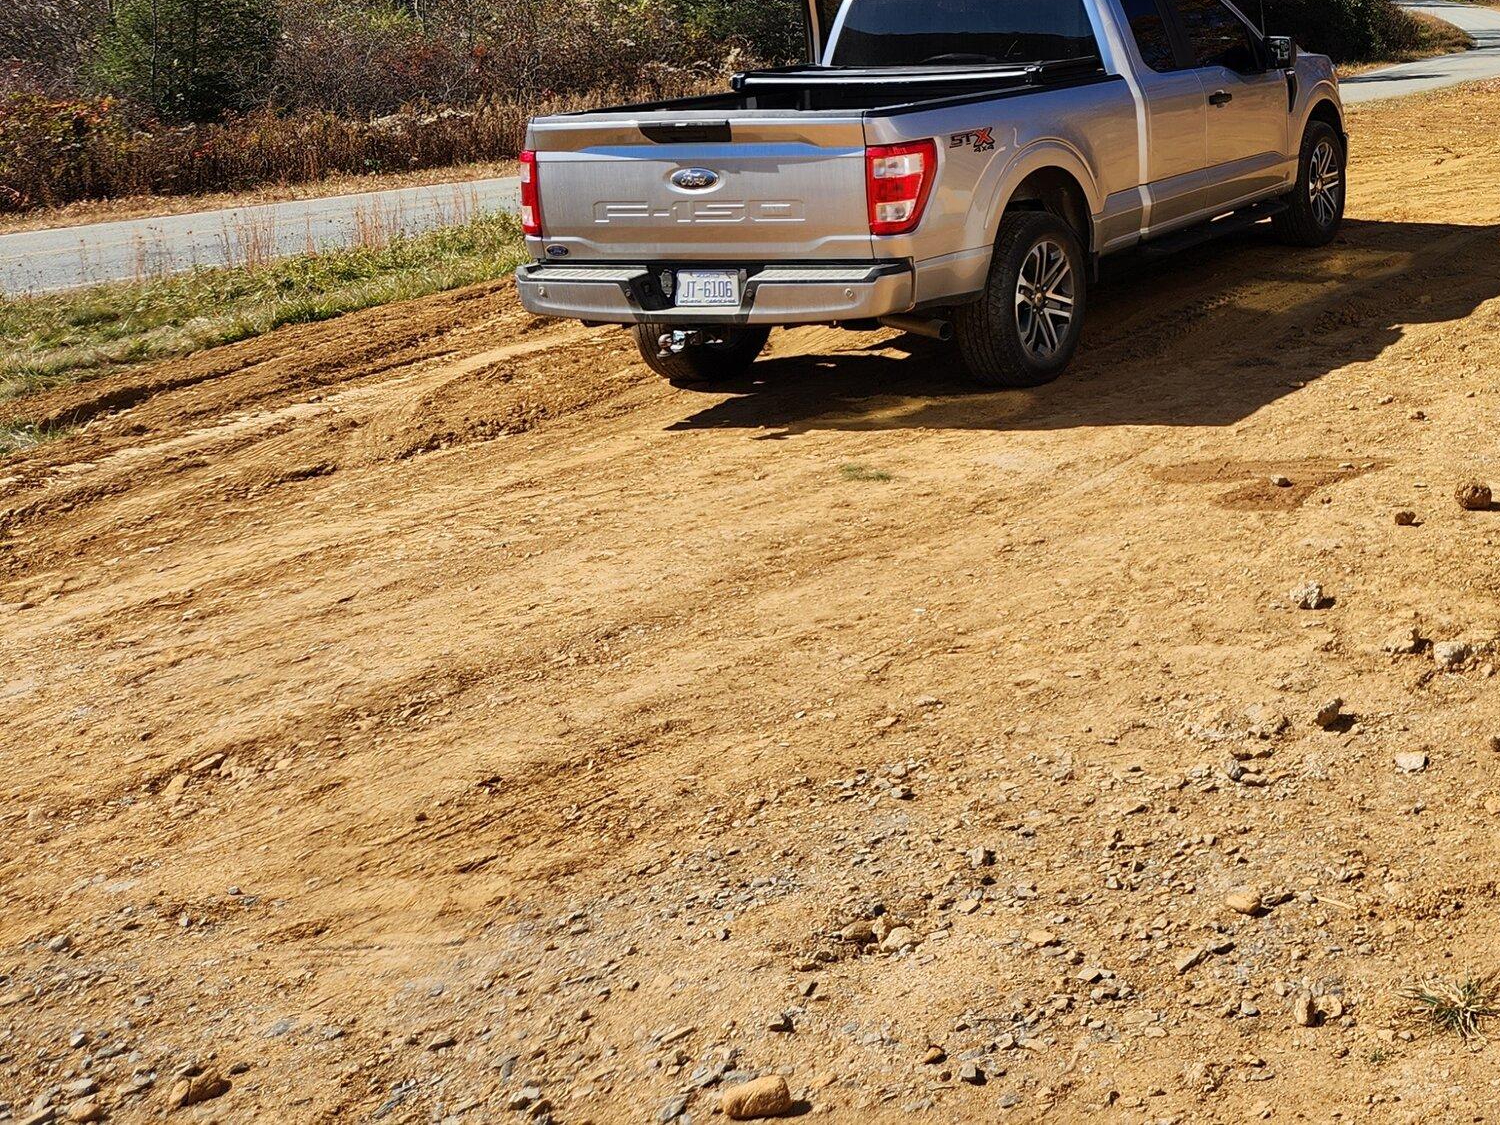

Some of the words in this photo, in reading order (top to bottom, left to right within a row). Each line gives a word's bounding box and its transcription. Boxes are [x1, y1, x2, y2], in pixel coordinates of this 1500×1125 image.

[949, 127, 995, 148] STX
[680, 171, 708, 186] Ford
[592, 200, 805, 223] F-150
